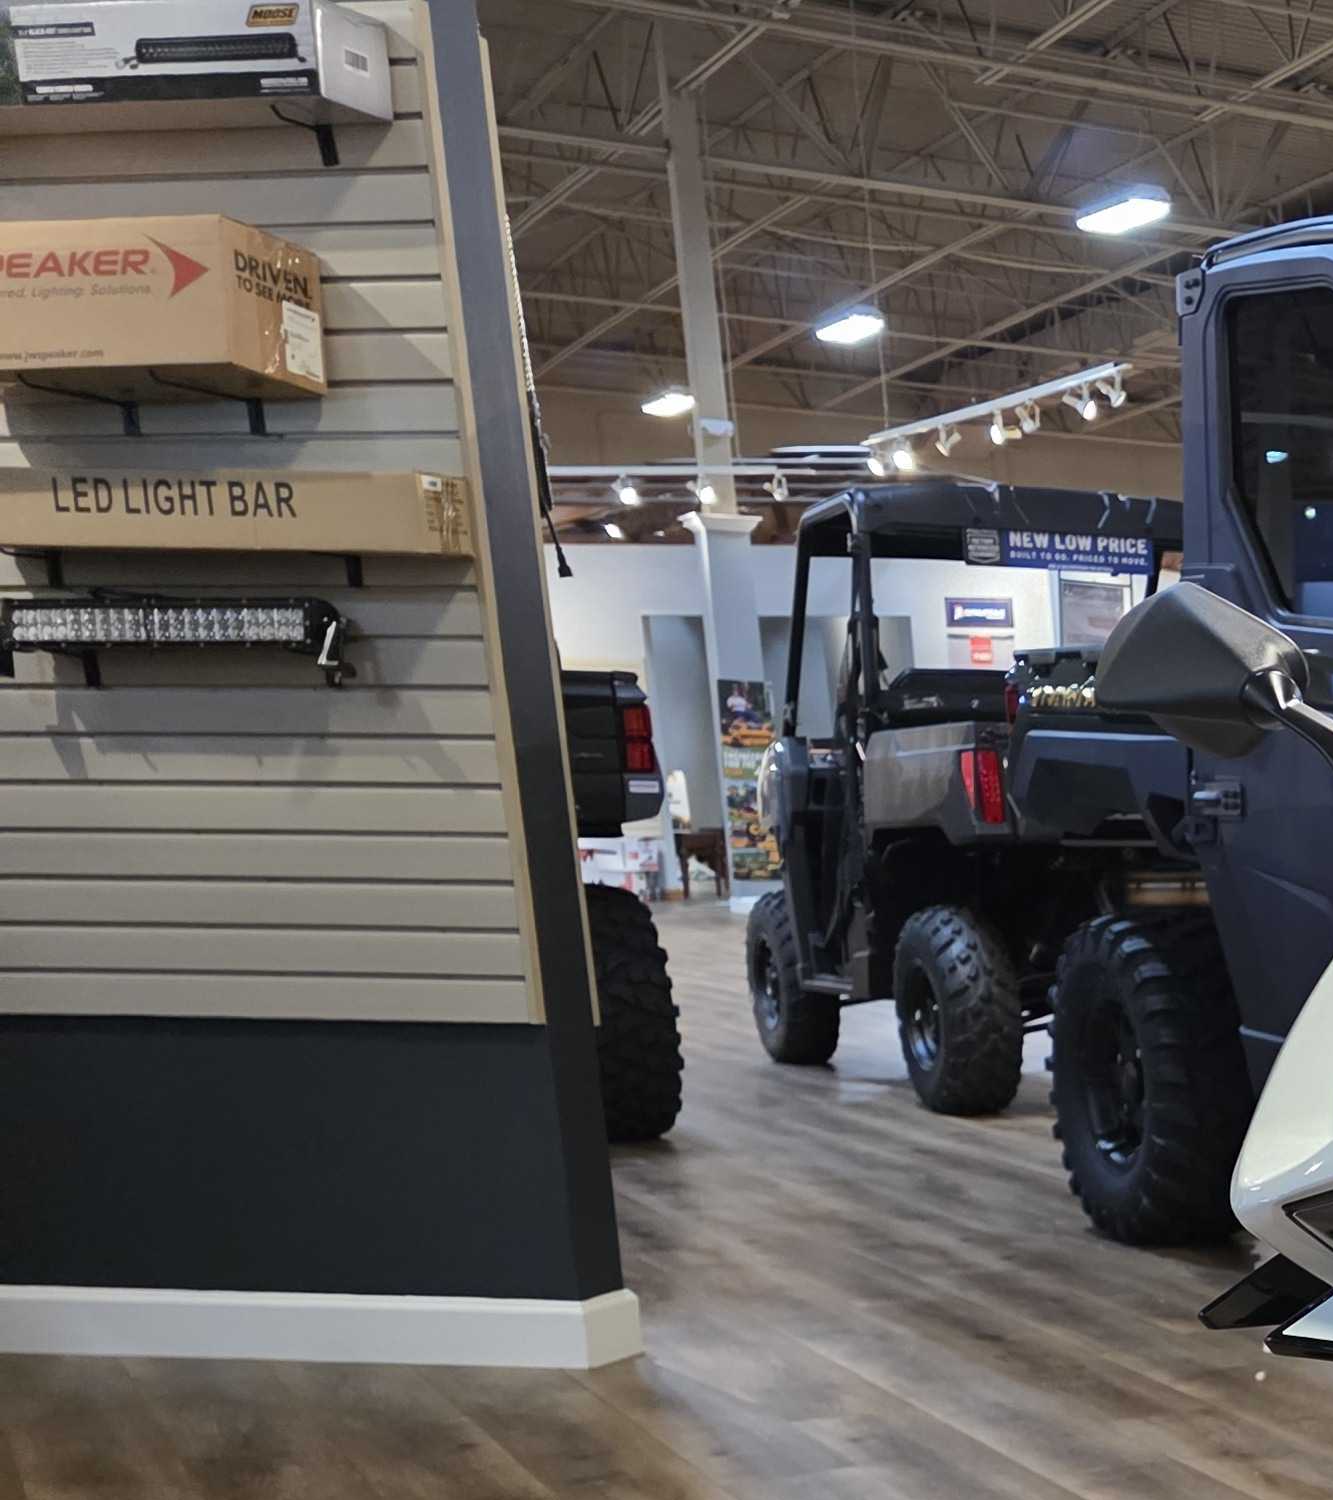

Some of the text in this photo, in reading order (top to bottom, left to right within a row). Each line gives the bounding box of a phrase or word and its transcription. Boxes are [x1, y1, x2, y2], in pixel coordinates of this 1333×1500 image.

[251, 8, 295, 20] MOOSE
[0, 249, 150, 279] EAKER
[236, 275, 253, 293] TO
[255, 283, 274, 301] SEE
[52, 476, 297, 518] LED LIGHT BAR
[1009, 531, 1048, 548] NEW
[1055, 534, 1091, 551] LOW
[1097, 538, 1148, 555] PRICE
[1010, 551, 1036, 560] BUILT
[1040, 552, 1051, 560] TO
